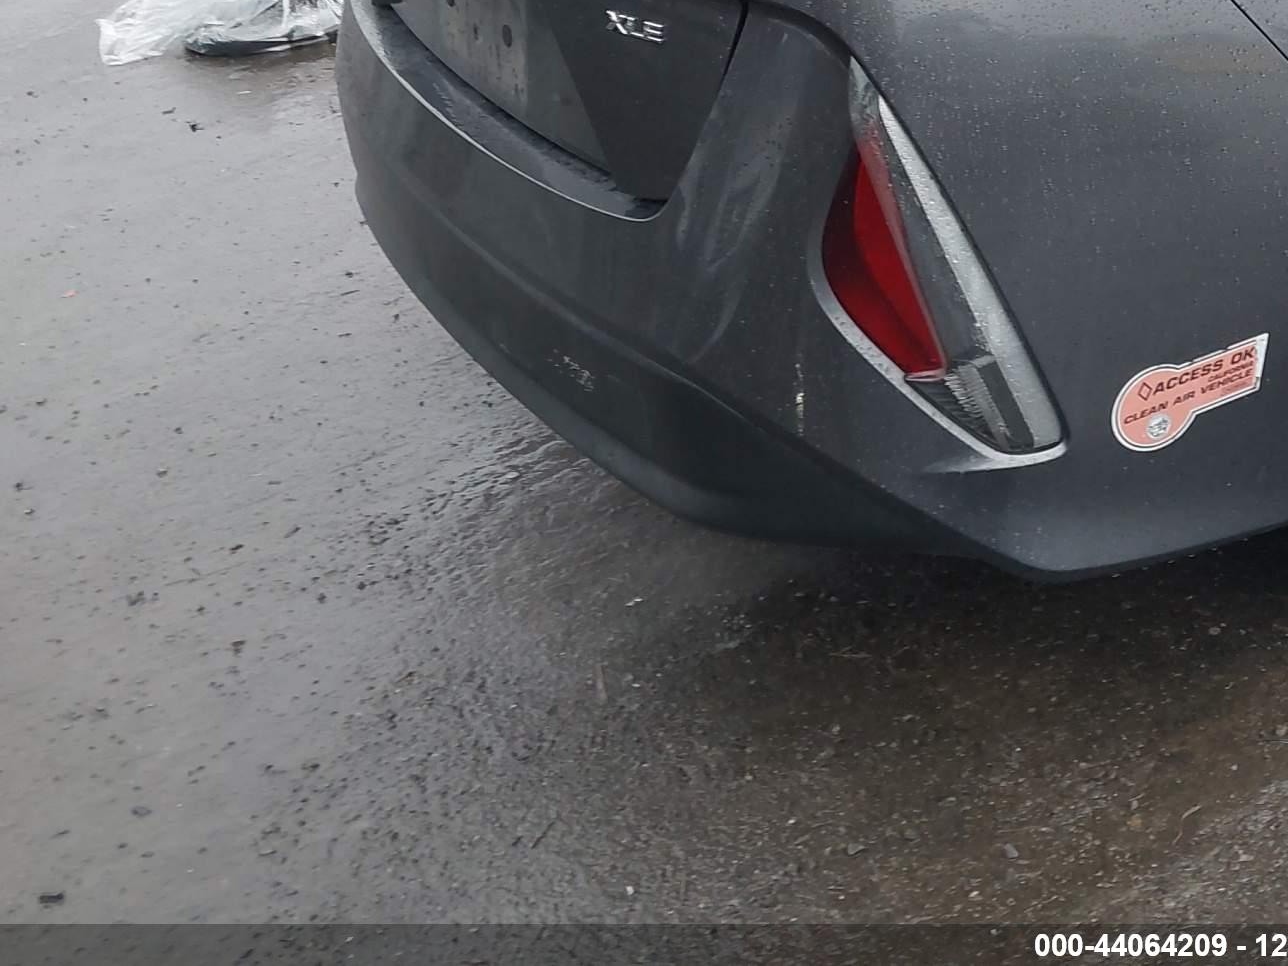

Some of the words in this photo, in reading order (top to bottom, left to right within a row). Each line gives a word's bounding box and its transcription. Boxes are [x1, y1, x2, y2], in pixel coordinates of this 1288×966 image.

[605, 9, 664, 41] XLE
[1153, 359, 1223, 396] ACCESS
[1230, 346, 1256, 365] OK
[1123, 401, 1169, 425] CLEAN
[1173, 390, 1196, 407] AIR
[1200, 368, 1254, 395] VEHICLE
